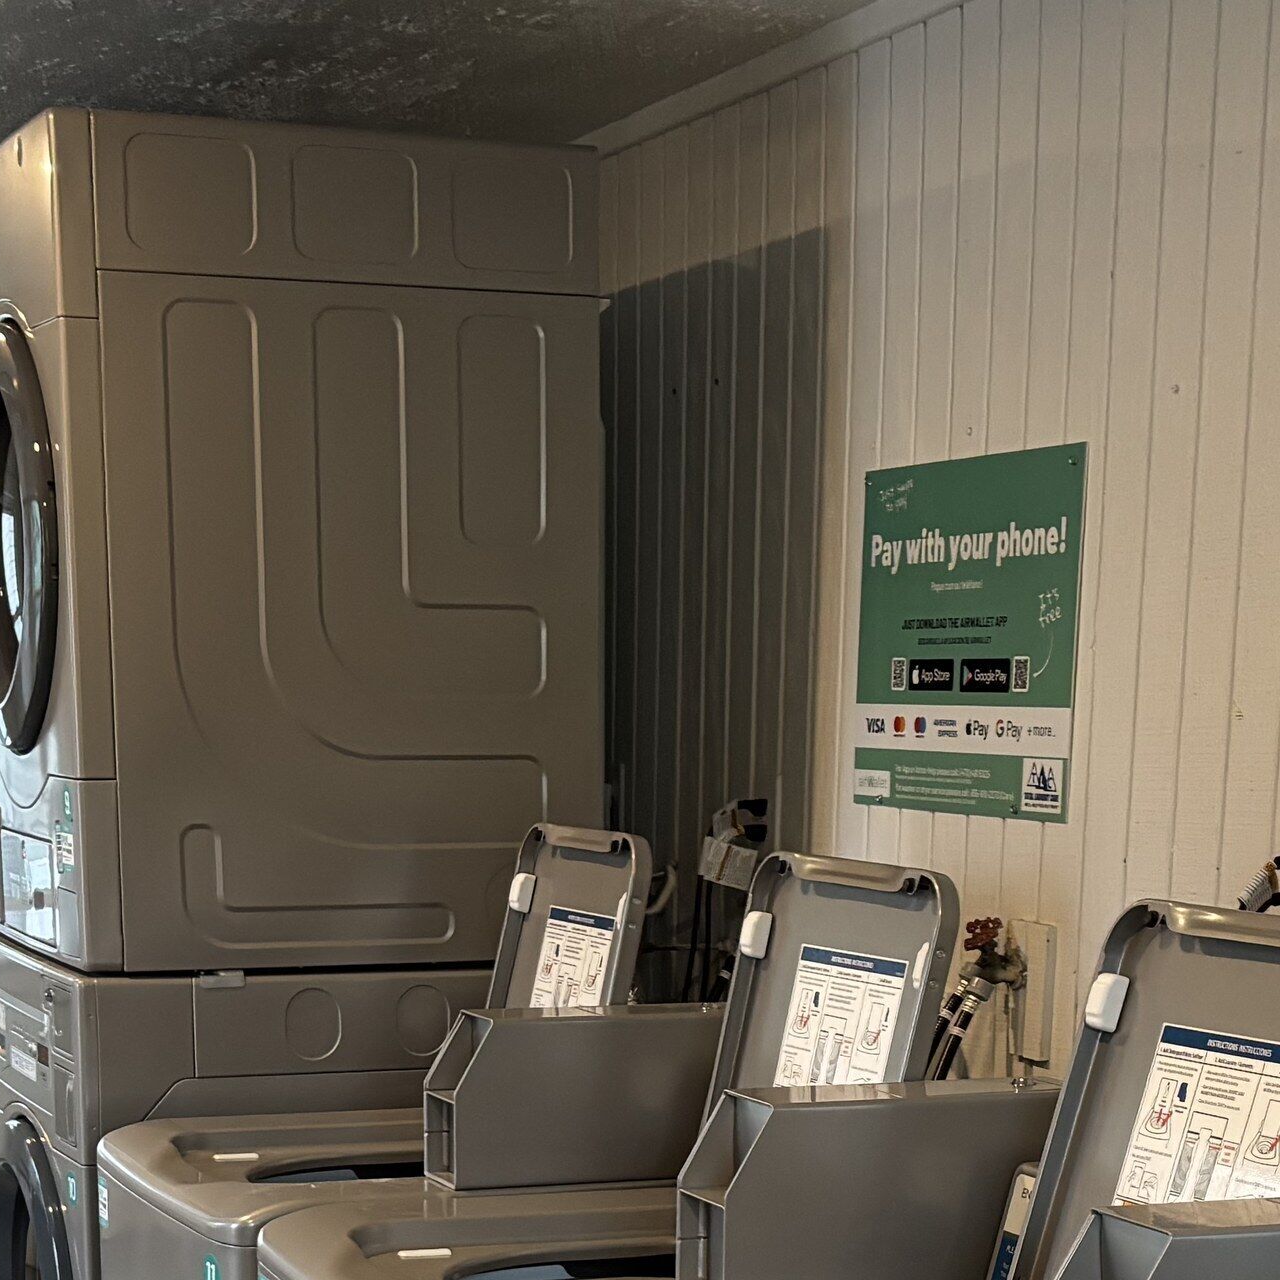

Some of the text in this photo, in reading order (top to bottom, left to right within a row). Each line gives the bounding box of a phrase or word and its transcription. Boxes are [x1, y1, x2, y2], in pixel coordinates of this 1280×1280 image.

[871, 516, 1068, 575] Pay with your phone!
[947, 617, 960, 628] THE
[996, 616, 1008, 627] APP
[921, 668, 950, 683] App Store
[974, 669, 1008, 685] Google Play
[865, 717, 886, 734] VISA
[973, 720, 989, 741] Pay
[1006, 720, 1023, 742] Pay
